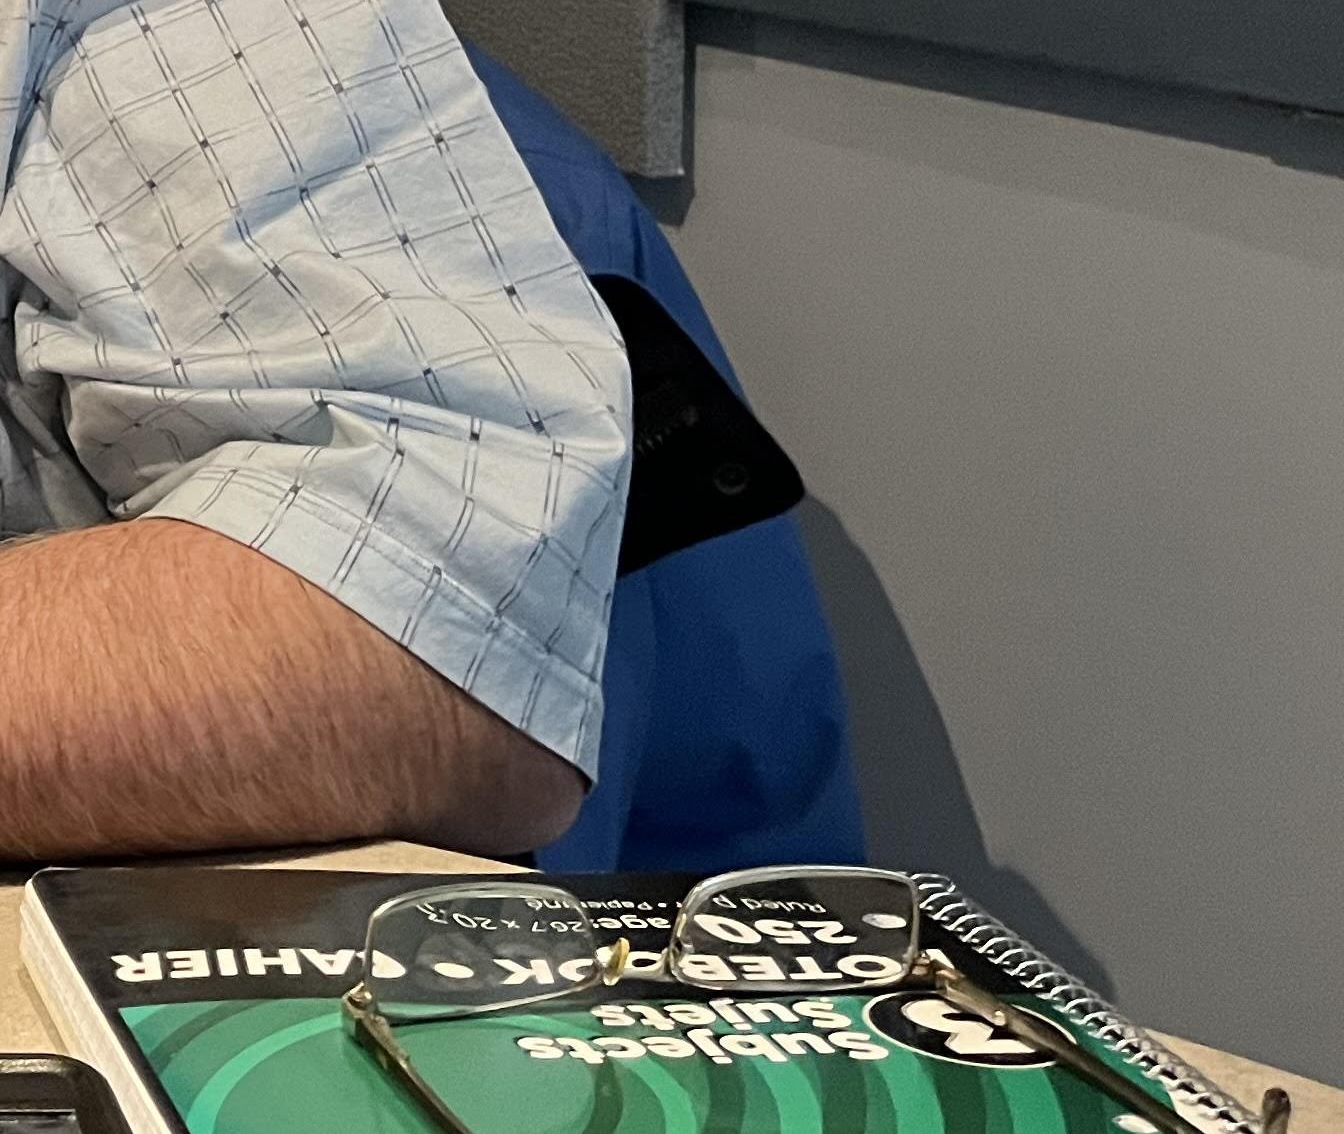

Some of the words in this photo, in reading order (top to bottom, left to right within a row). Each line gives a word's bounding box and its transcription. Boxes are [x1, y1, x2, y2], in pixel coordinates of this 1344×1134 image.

[589, 913, 671, 930] age
[741, 896, 826, 914] Ruled
[691, 913, 858, 945] 250
[493, 948, 954, 985] OTEBOOK
[590, 997, 852, 1031] Sujets
[901, 998, 1036, 1055] 3
[516, 1027, 889, 1065] Subjects
